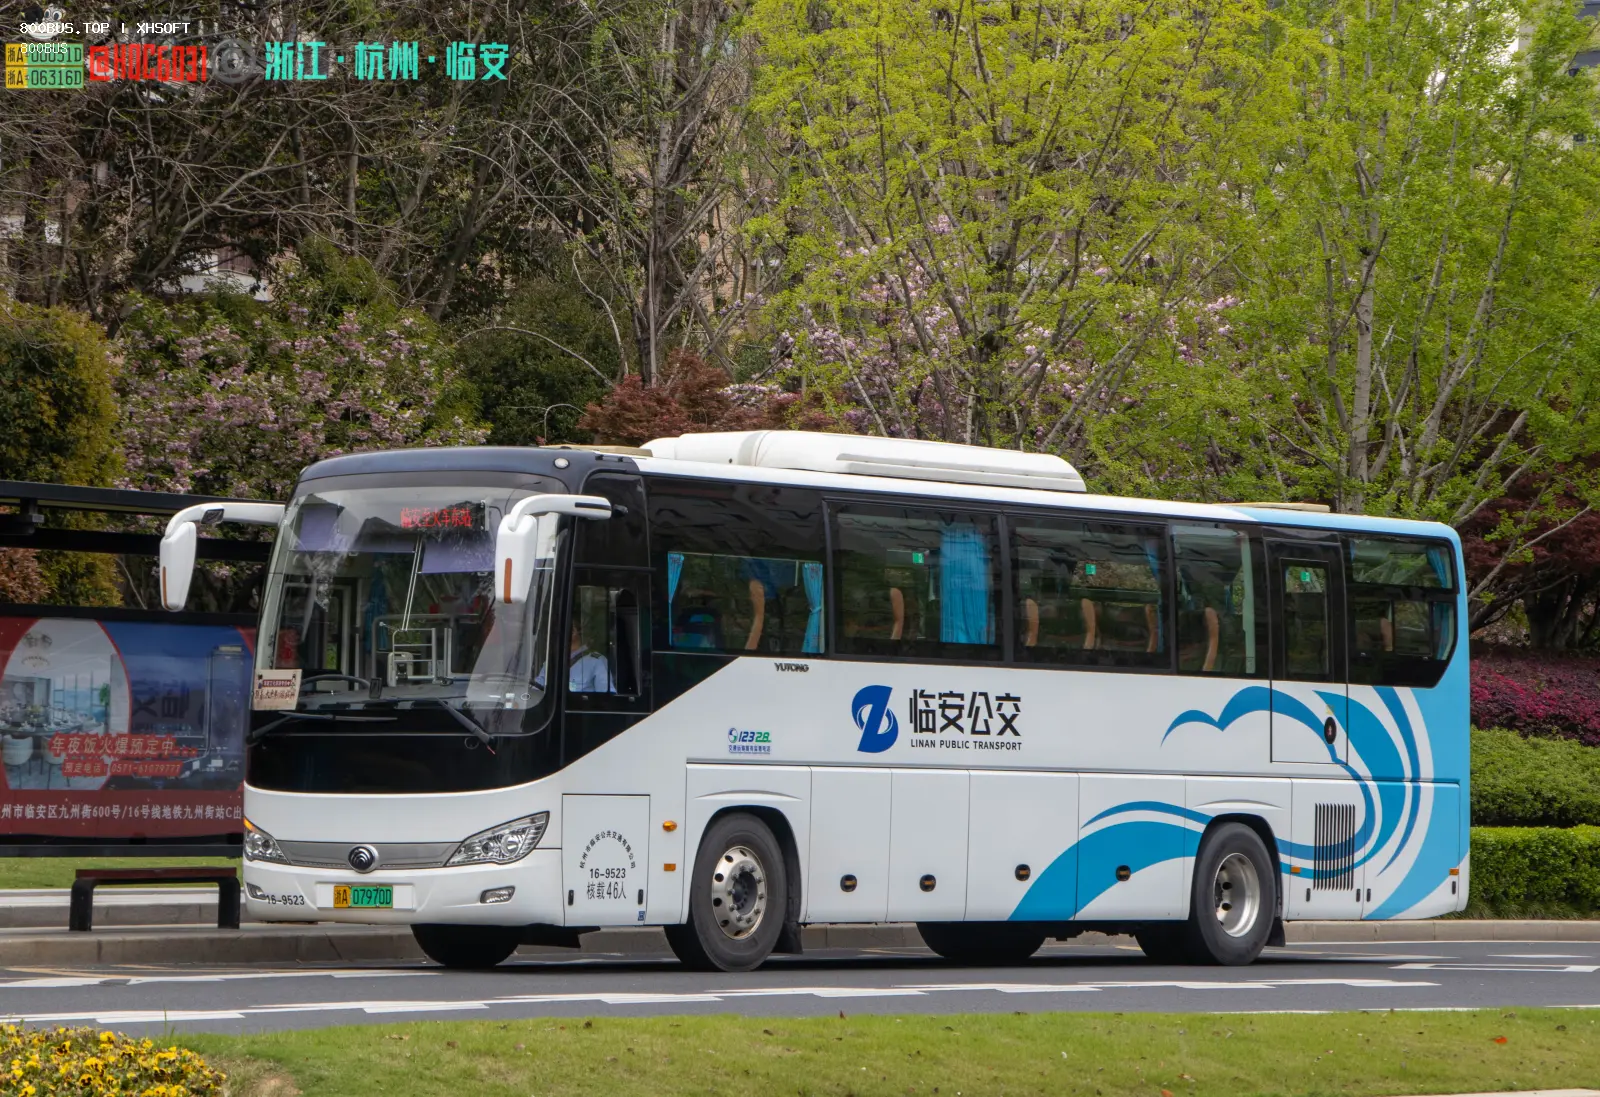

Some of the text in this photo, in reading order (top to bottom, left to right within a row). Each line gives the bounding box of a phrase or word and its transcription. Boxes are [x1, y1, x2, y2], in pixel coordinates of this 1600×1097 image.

[774, 662, 810, 672] YUTONG
[909, 689, 1021, 736] 临安公交
[738, 731, 772, 743] 12328
[910, 739, 1022, 750] LINAN PUBLIC TRANSPORT
[589, 868, 626, 879] 16-9523
[586, 881, 627, 899] 核载46人
[266, 894, 305, 906] 16-9523
